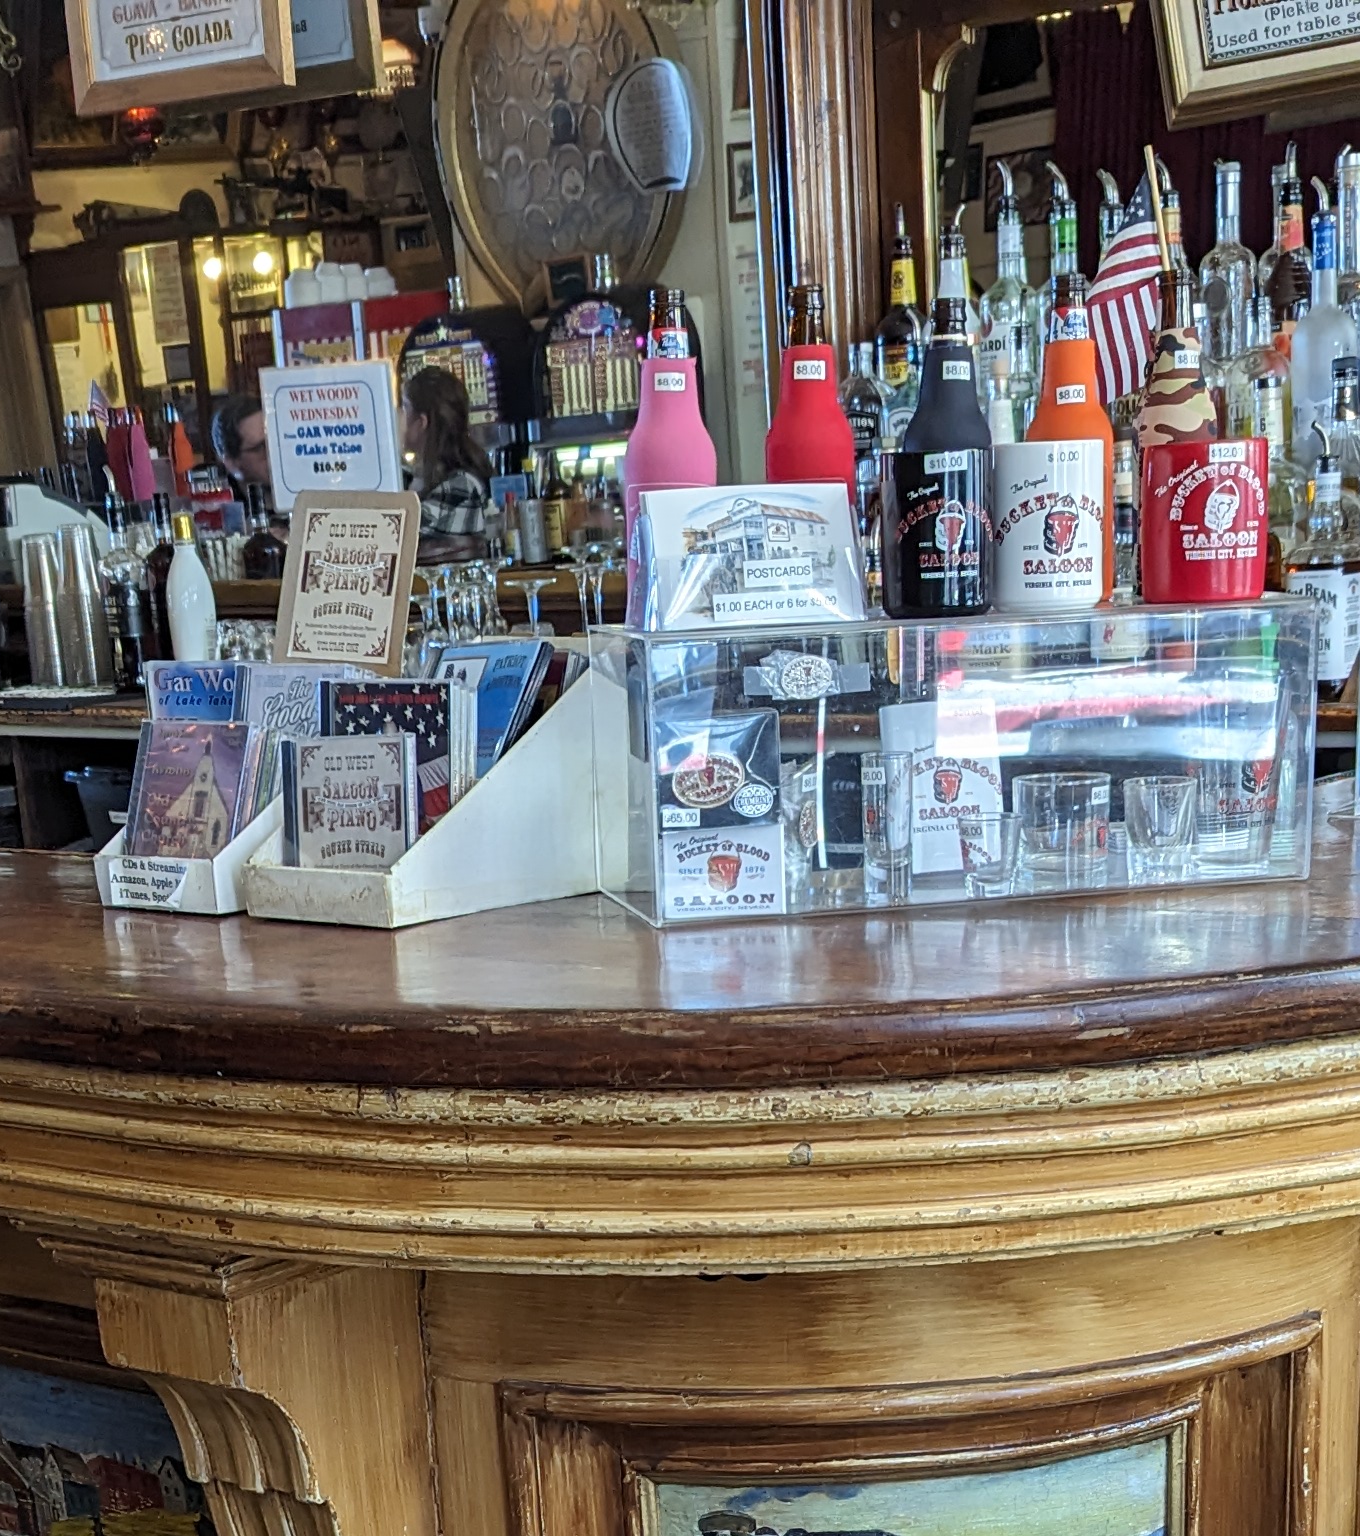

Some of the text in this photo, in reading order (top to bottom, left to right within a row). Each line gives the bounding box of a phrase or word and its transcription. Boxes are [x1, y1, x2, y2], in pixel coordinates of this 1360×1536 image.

[112, 2, 158, 24] GUAVA
[171, 19, 234, 53] COLADA
[1216, 29, 1258, 48] Used
[1264, 23, 1291, 40] for
[1297, 13, 1341, 34] table
[796, 365, 822, 376] $8.00
[289, 386, 360, 404] WET WOODY
[1058, 388, 1085, 400] $8.00
[289, 405, 360, 422] WEDNESDAY
[297, 425, 322, 439] GAR
[323, 423, 366, 438] WOODS
[329, 441, 363, 455] Tahoe
[1047, 450, 1080, 463] $0.00
[313, 460, 348, 474] $10.00
[929, 456, 963, 470] $10.00
[1154, 459, 1200, 498] The Original
[1169, 462, 1219, 522] BUCKET
[328, 522, 378, 539] OLD WEST
[1182, 529, 1259, 549] SALOON
[323, 541, 379, 566] SALOON
[747, 564, 811, 579] POSTCARDS
[1022, 556, 1094, 575] SALOON
[323, 570, 371, 596] PIANO
[1305, 583, 1338, 609] BEAM
[715, 601, 742, 613] $1.00
[744, 600, 773, 611] EACH
[775, 601, 784, 610] or
[787, 599, 794, 608] 6
[796, 597, 807, 608] for
[154, 668, 193, 692] Gar
[159, 694, 234, 707] of Lake Taho
[345, 754, 376, 771] WEST
[322, 775, 380, 801] SALOON
[327, 807, 377, 833] PIANO
[918, 804, 981, 821] SALOON
[912, 824, 945, 834] IRGINIA
[673, 832, 719, 852] The Original
[675, 841, 771, 864] BUCKET BLOOD
[122, 858, 138, 869] CDs
[678, 867, 704, 876] SINCE
[150, 876, 174, 891] Apple
[673, 893, 776, 908] SALOON
